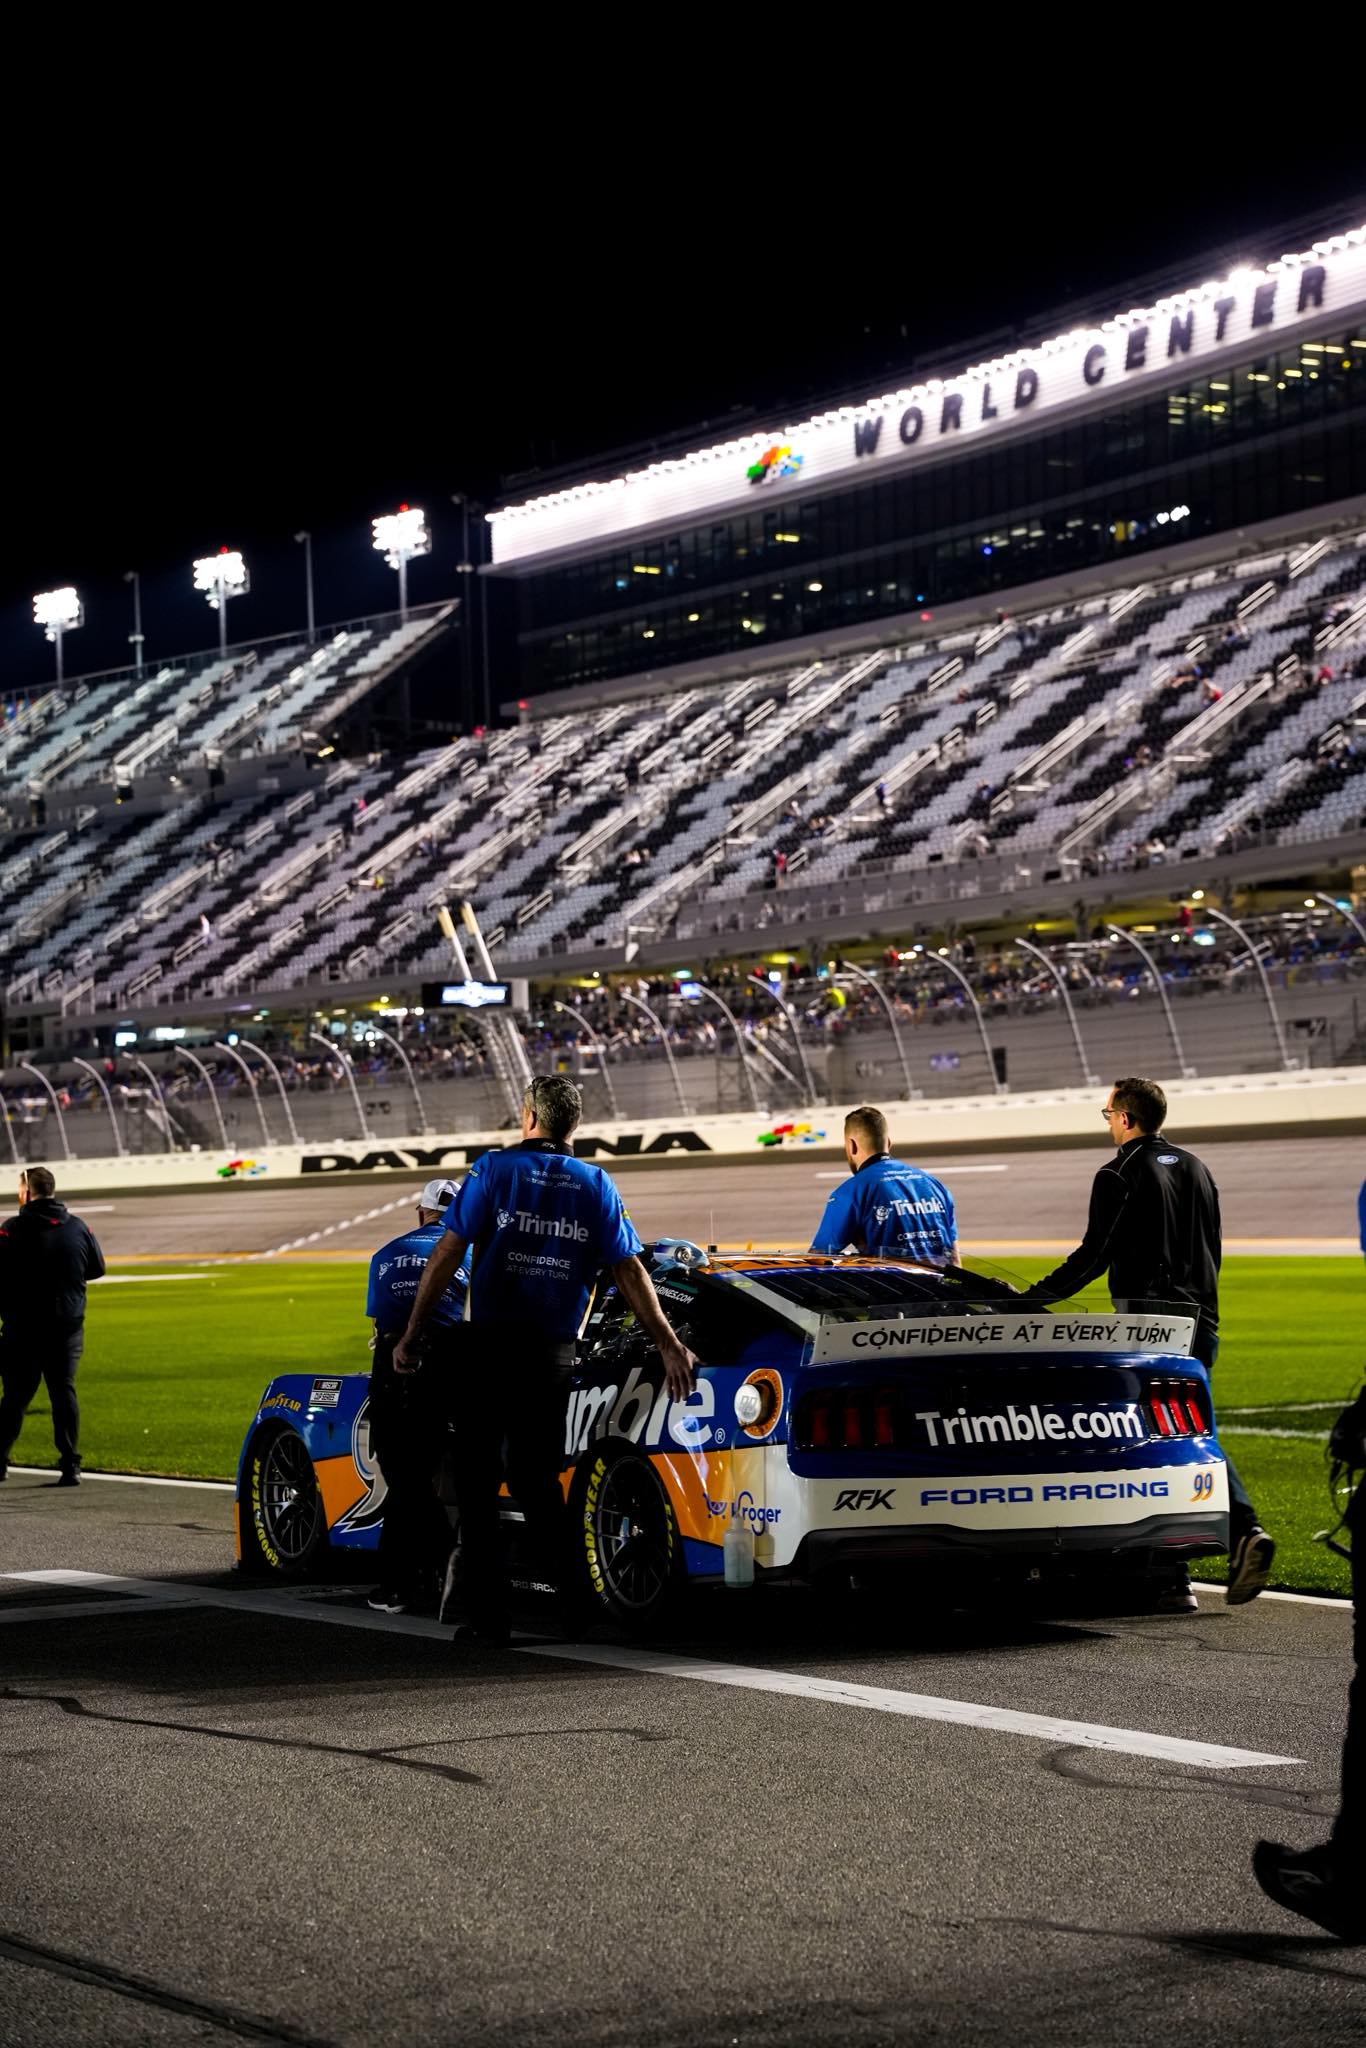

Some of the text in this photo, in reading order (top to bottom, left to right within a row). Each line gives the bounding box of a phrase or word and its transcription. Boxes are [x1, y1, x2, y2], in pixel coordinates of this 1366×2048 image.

[854, 265, 1327, 457] WORLD CENTER
[301, 1130, 714, 1174] DAYTNA
[515, 1210, 589, 1242] Trimble
[505, 1264, 570, 1281] AT EVERY TURN
[507, 1251, 571, 1269] CONFIDENCE
[852, 1325, 1004, 1348] CONFIDENCE
[1013, 1324, 1043, 1342] AT
[1052, 1325, 1116, 1342] EVERY
[915, 1404, 1145, 1447] Trimble.com
[832, 1471, 1216, 1511] RFK FORD RACING 99
[583, 1457, 607, 1593] GOODYEAR
